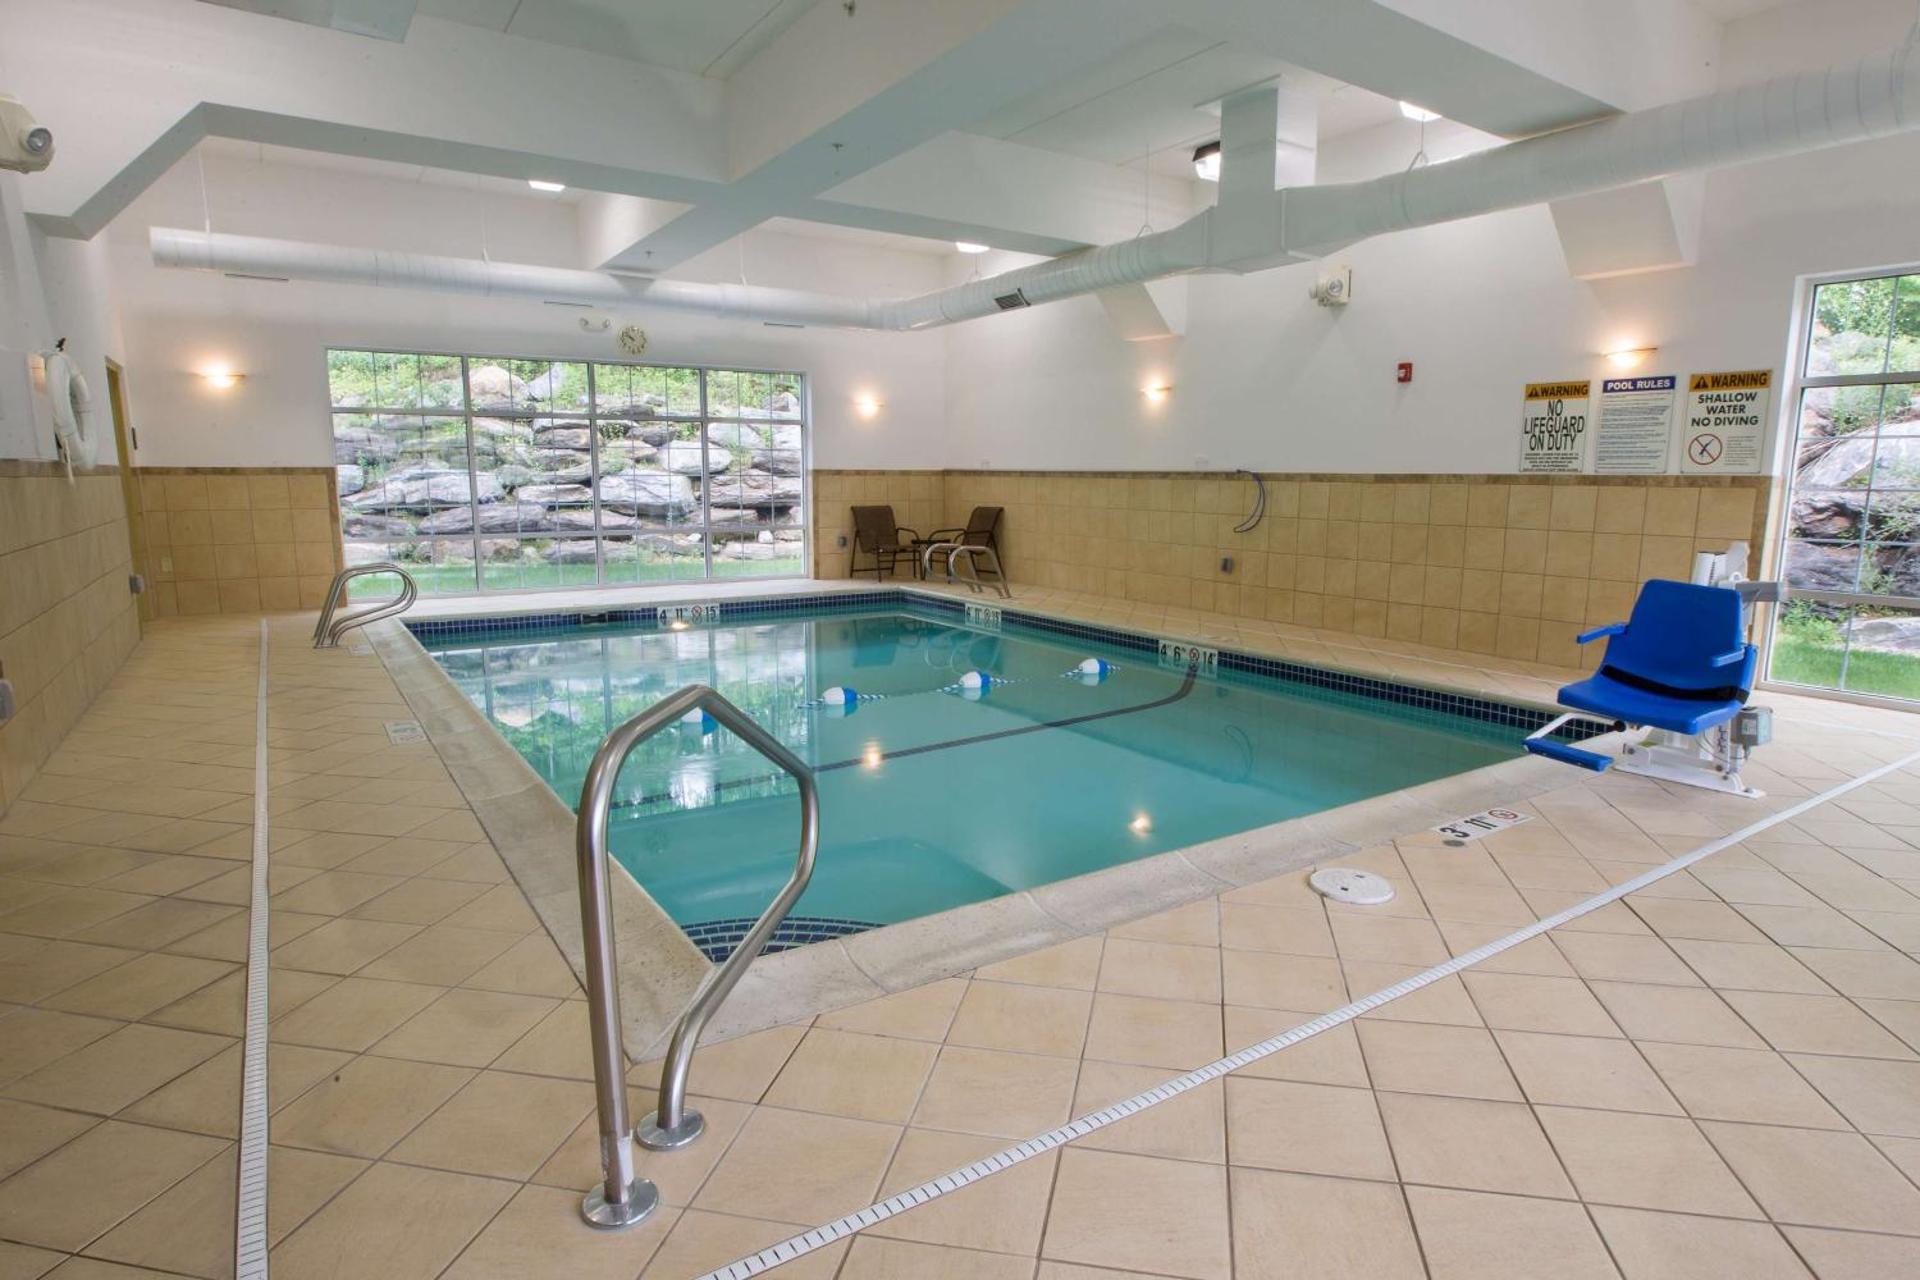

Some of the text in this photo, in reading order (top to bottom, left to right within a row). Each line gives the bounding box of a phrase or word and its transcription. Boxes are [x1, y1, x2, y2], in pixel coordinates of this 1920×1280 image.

[1607, 379, 1671, 391] POOL RULES
[1711, 373, 1768, 387] WARNING
[1541, 384, 1588, 397] WARNING
[1698, 392, 1758, 404] SHALLOW
[1547, 399, 1563, 416] NO
[1706, 404, 1746, 415] WATER
[1524, 416, 1585, 434] LIFEGUARD
[1691, 415, 1759, 427] NO DIVING
[1529, 433, 1577, 452] ON DUTY
